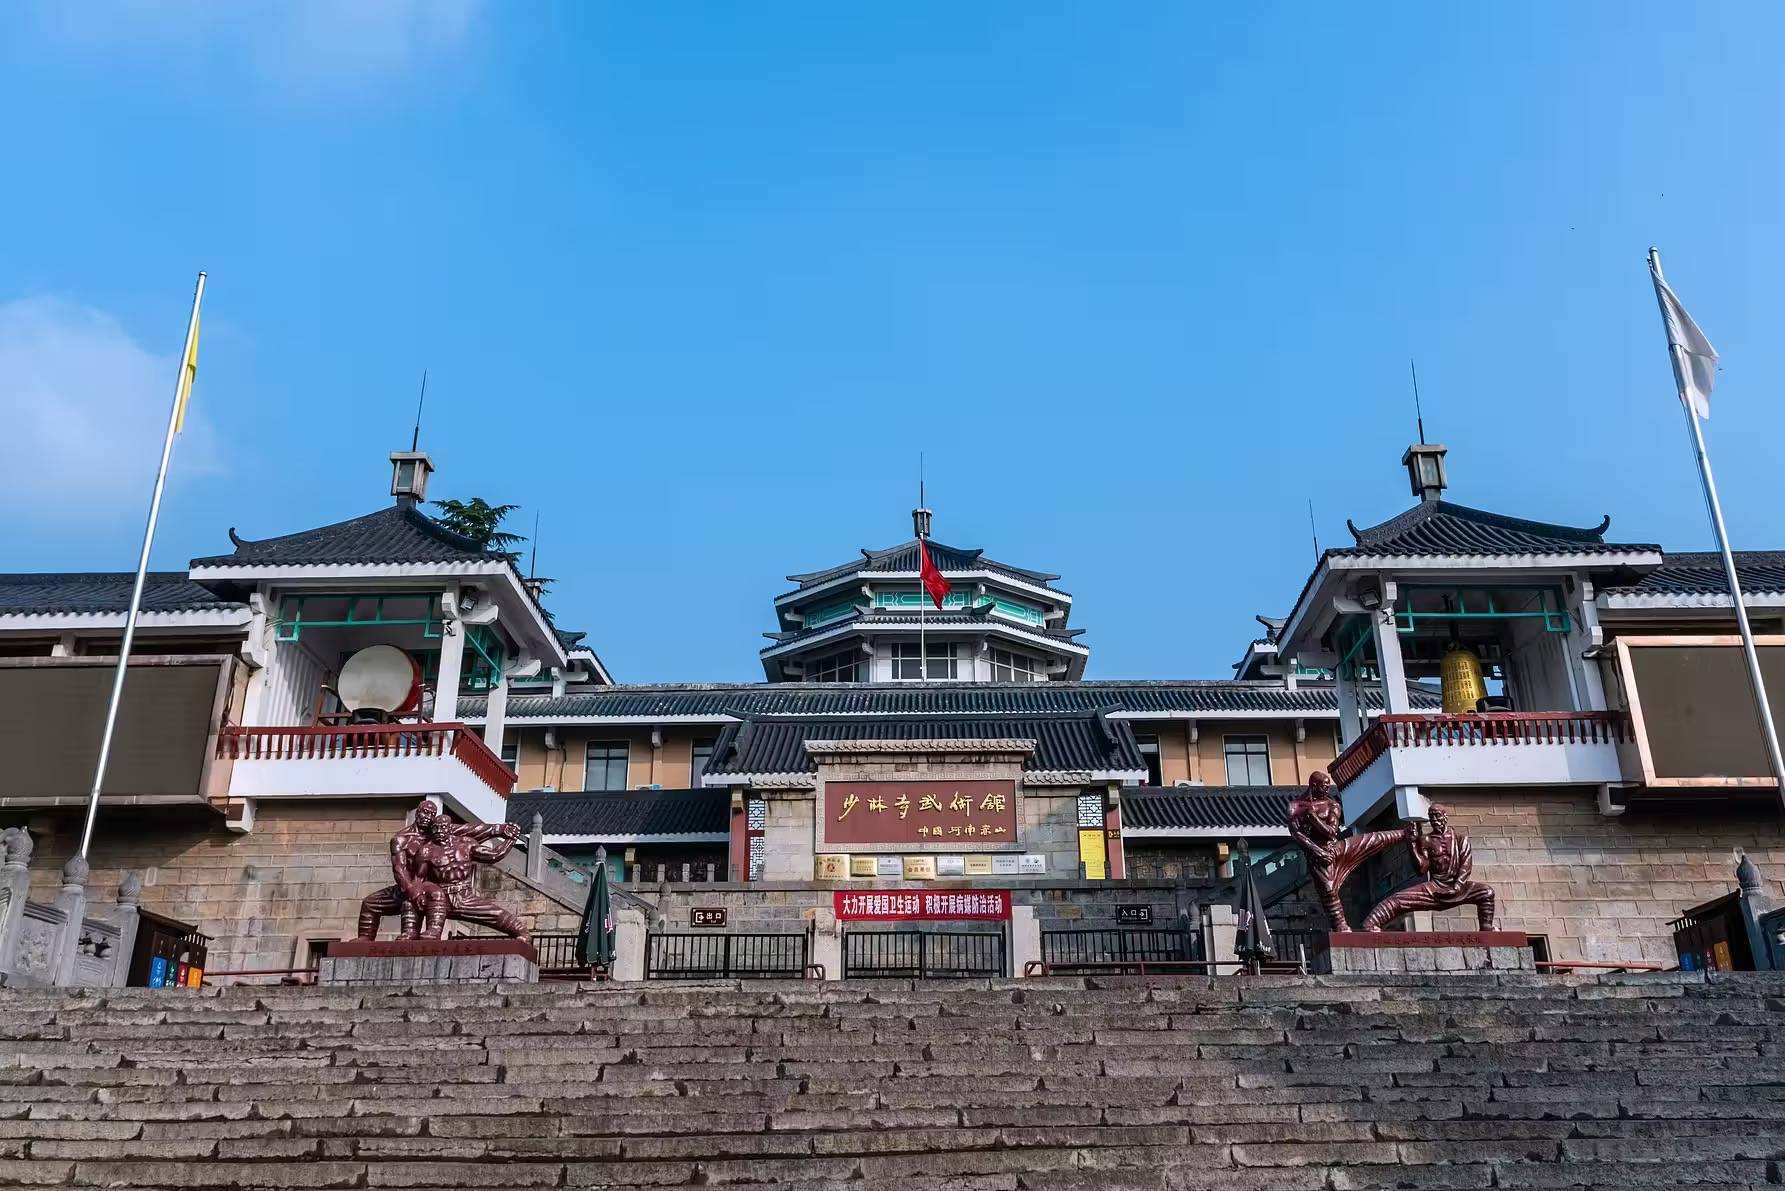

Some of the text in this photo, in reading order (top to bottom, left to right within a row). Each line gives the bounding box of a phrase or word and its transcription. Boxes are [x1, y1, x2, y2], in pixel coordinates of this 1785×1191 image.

[843, 894, 1002, 915] 大力开展爱国卫生运动 积极开展病媒防治活动
[706, 912, 722, 920] 出口
